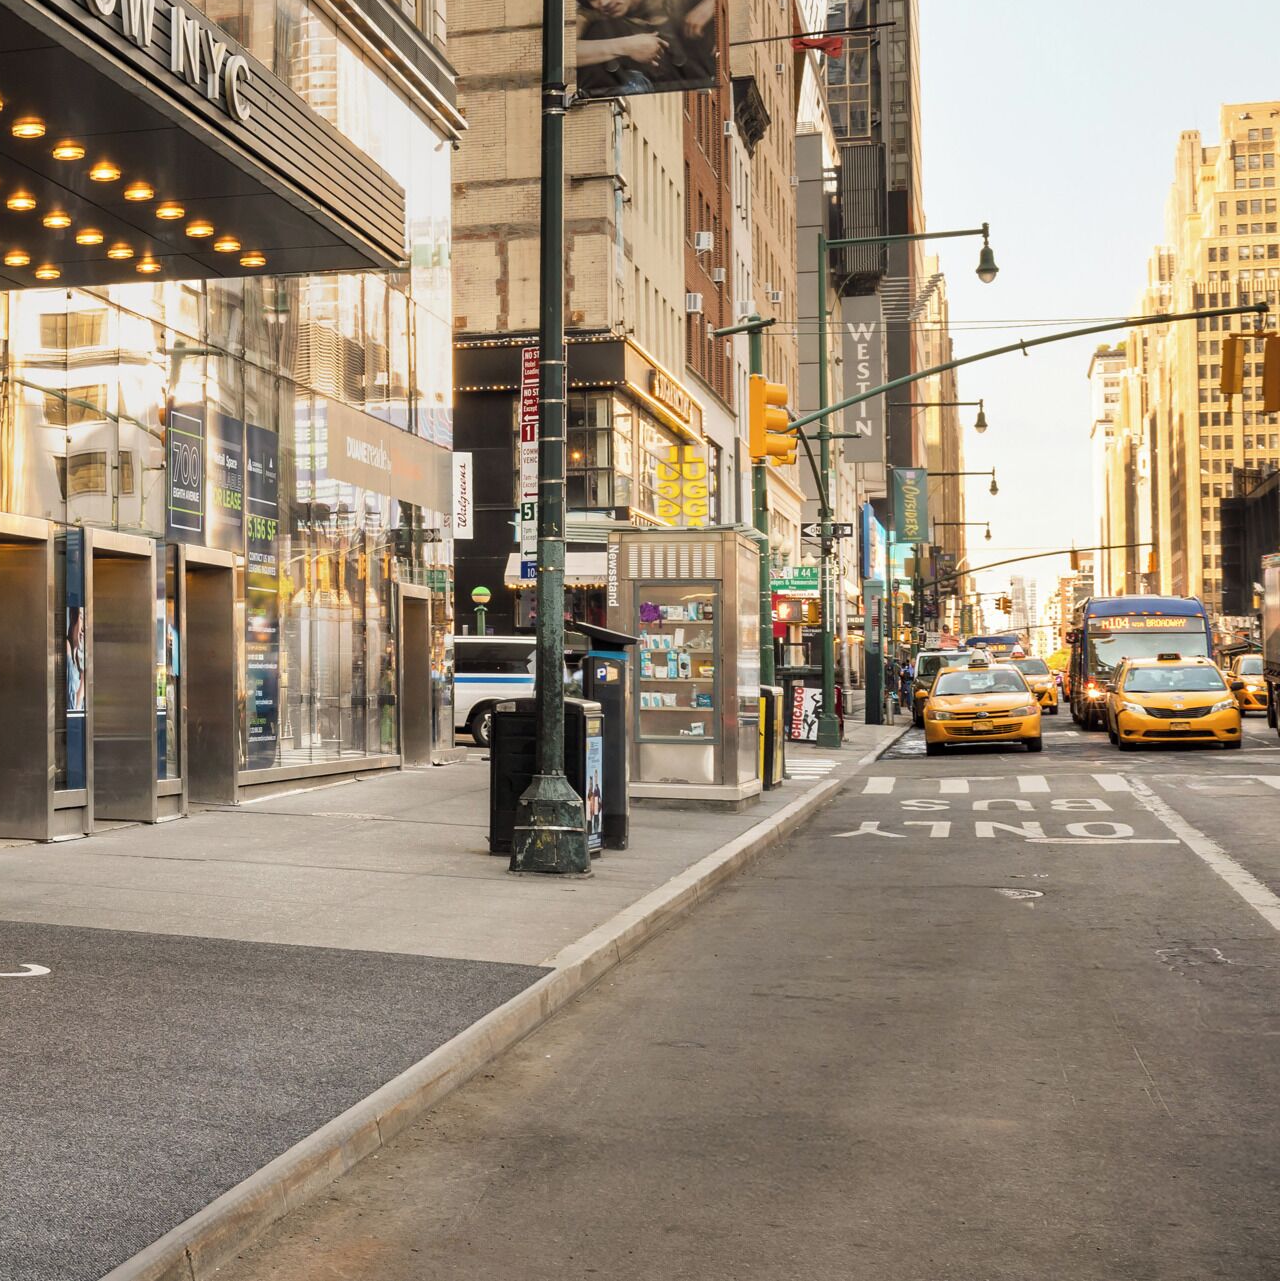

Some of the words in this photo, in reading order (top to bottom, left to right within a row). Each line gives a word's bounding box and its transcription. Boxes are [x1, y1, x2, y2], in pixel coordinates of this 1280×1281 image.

[171, 6, 251, 121] NYC
[846, 321, 876, 438] WESTIN
[173, 442, 200, 487] 700
[226, 455, 238, 469] Space
[224, 488, 242, 511] LEASE
[457, 463, 470, 528] Walgreens
[524, 504, 532, 519] 5
[267, 520, 277, 541] SF
[608, 544, 620, 607] Newsstand
[801, 568, 811, 577] 44
[1101, 616, 1130, 630] M104
[1146, 618, 1186, 627] BROADWAY
[791, 687, 804, 739] CHICAGO
[899, 798, 1114, 812] BUS
[830, 821, 1135, 839] ONLY
